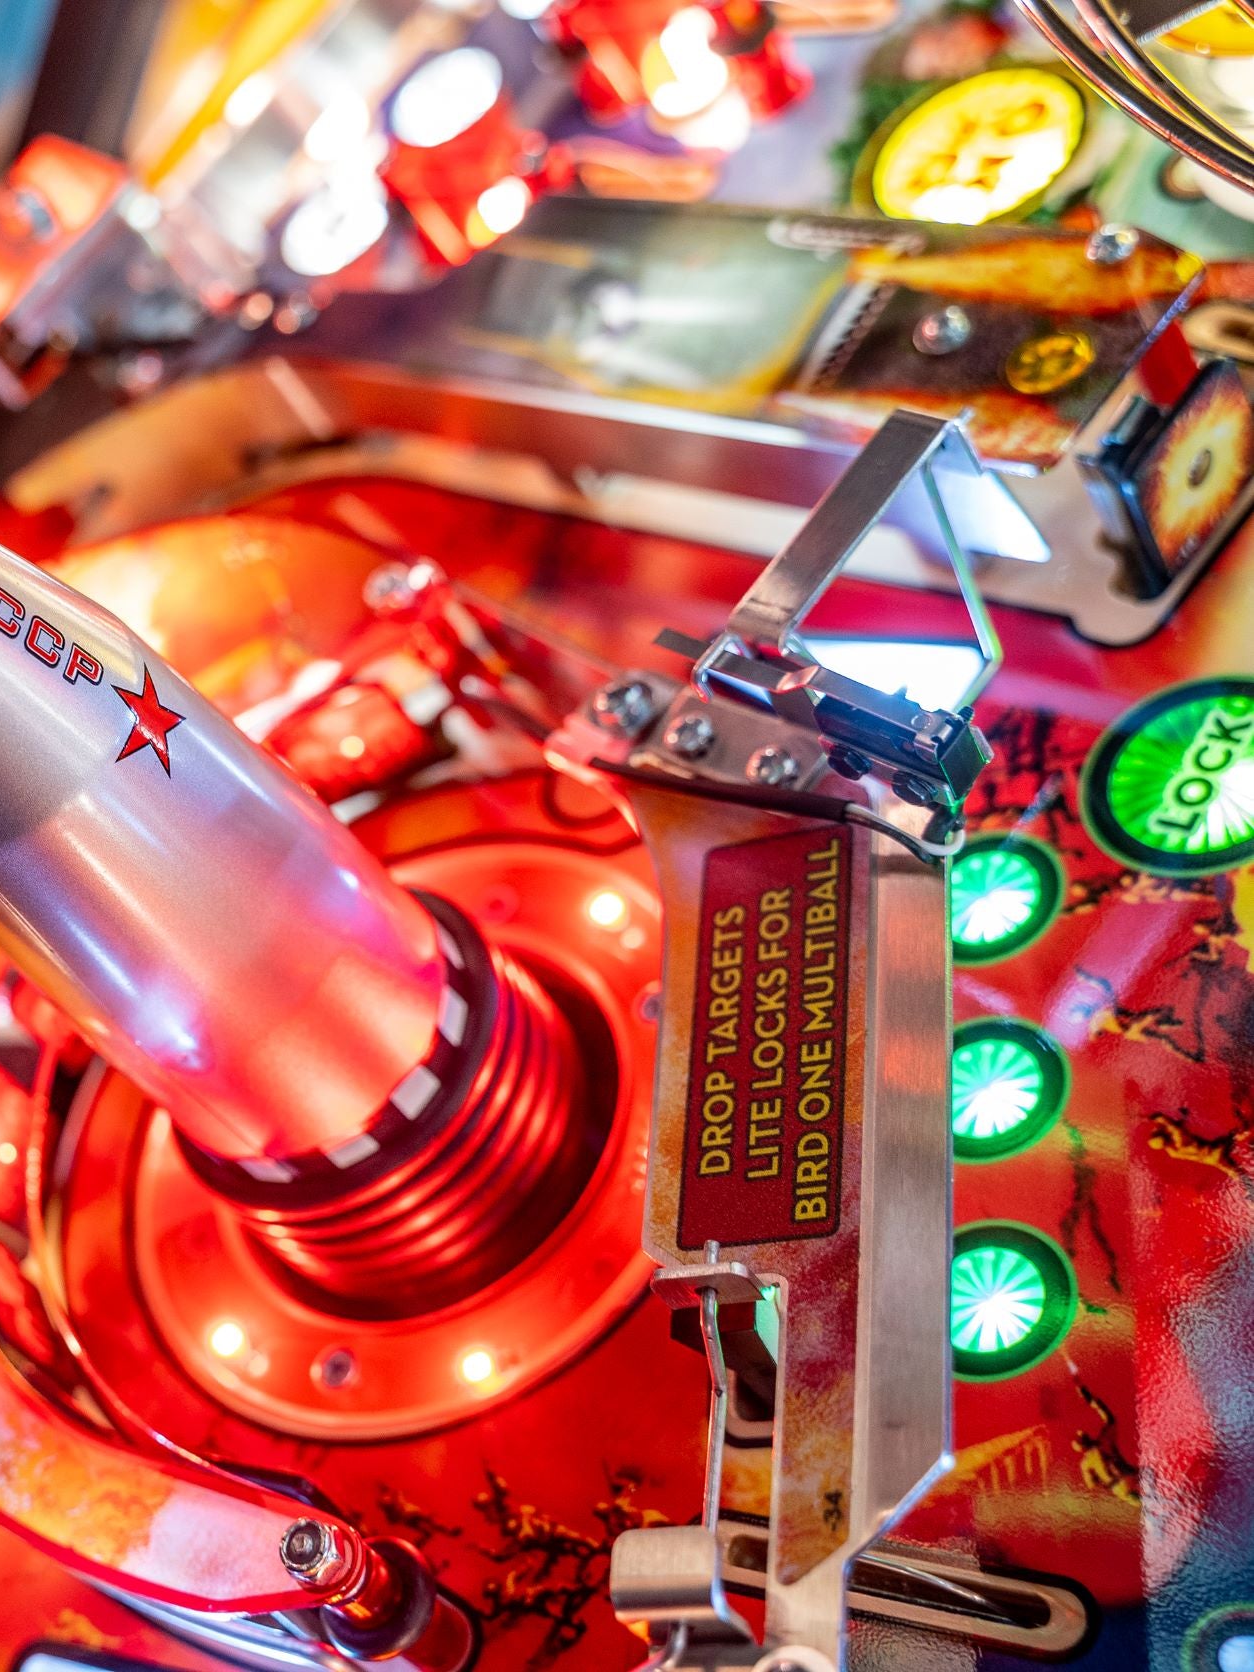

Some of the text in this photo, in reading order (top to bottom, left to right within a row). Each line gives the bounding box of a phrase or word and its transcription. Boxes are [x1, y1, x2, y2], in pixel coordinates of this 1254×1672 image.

[1157, 717, 1252, 830] LOCK
[699, 905, 745, 1175] DROP TARGETS
[747, 888, 793, 1178] LITE LOCKS FOR
[794, 838, 840, 1221] BIRD ONE MULTIBALL
